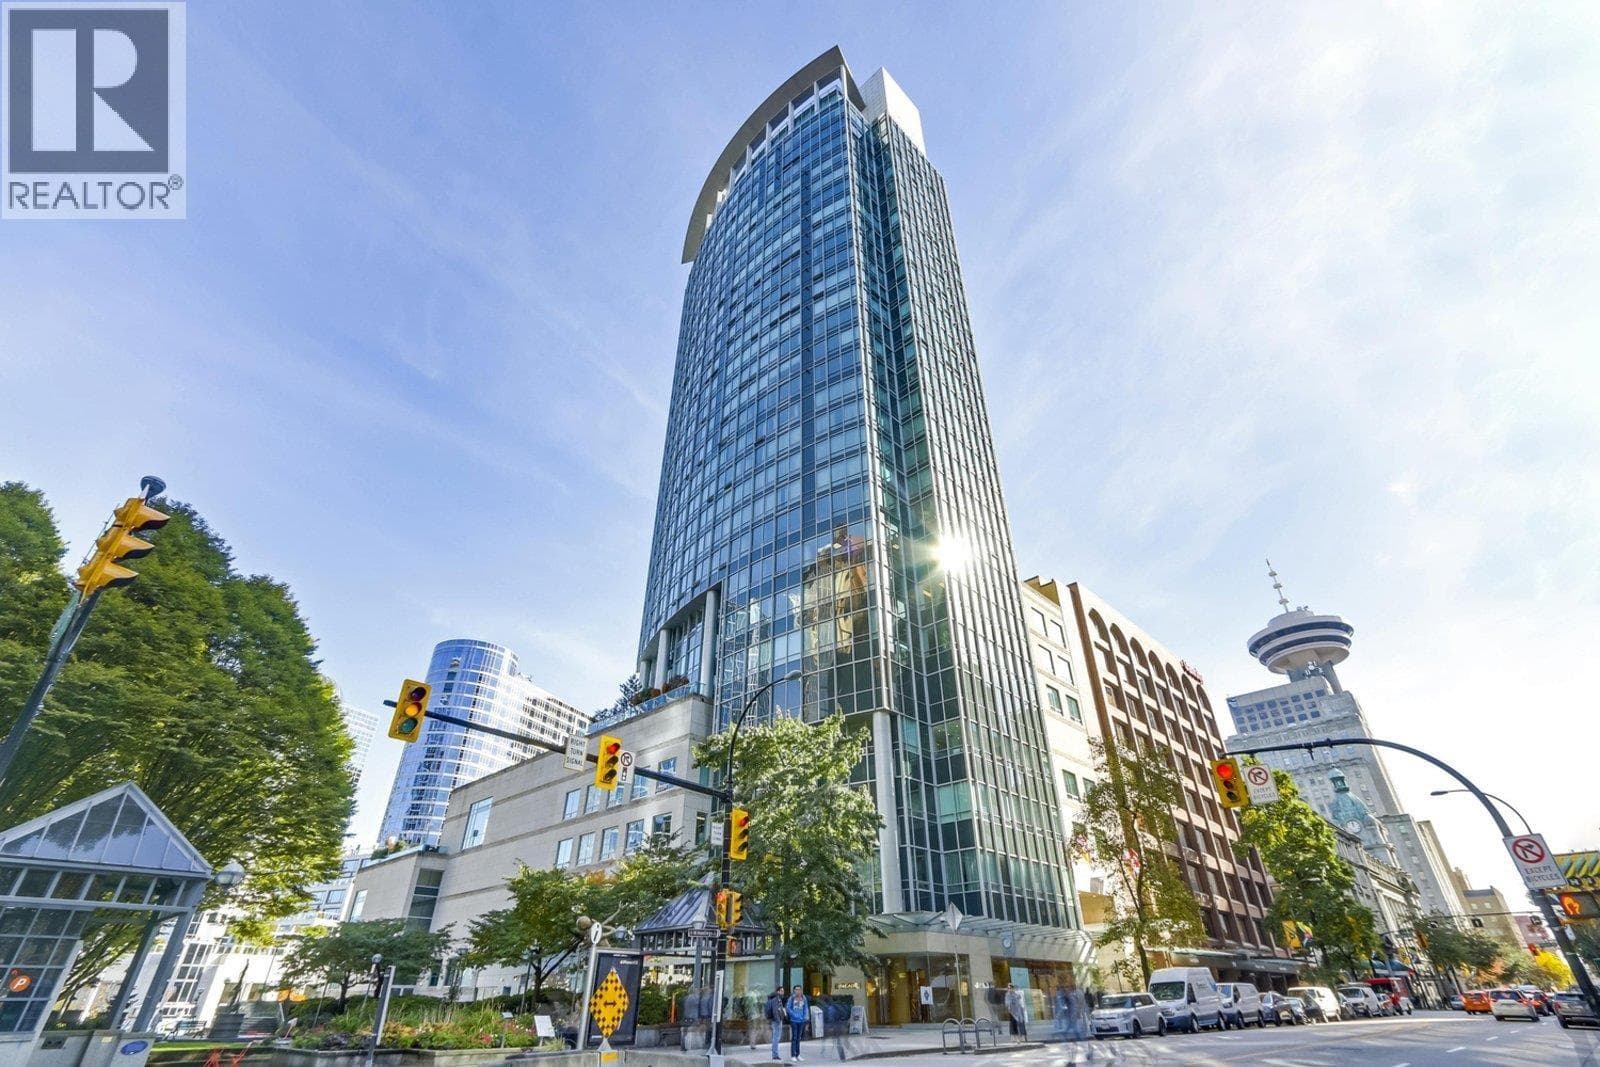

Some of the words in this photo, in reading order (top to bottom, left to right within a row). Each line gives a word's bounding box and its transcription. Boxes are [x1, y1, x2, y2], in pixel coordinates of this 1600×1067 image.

[570, 737, 586, 747] RIGHT
[570, 747, 584, 756] TURN
[566, 756, 584, 767] SIGNAL
[1524, 865, 1552, 874] EXCEPT
[1526, 873, 1560, 882] BICYCLES
[13, 978, 27, 989] P
